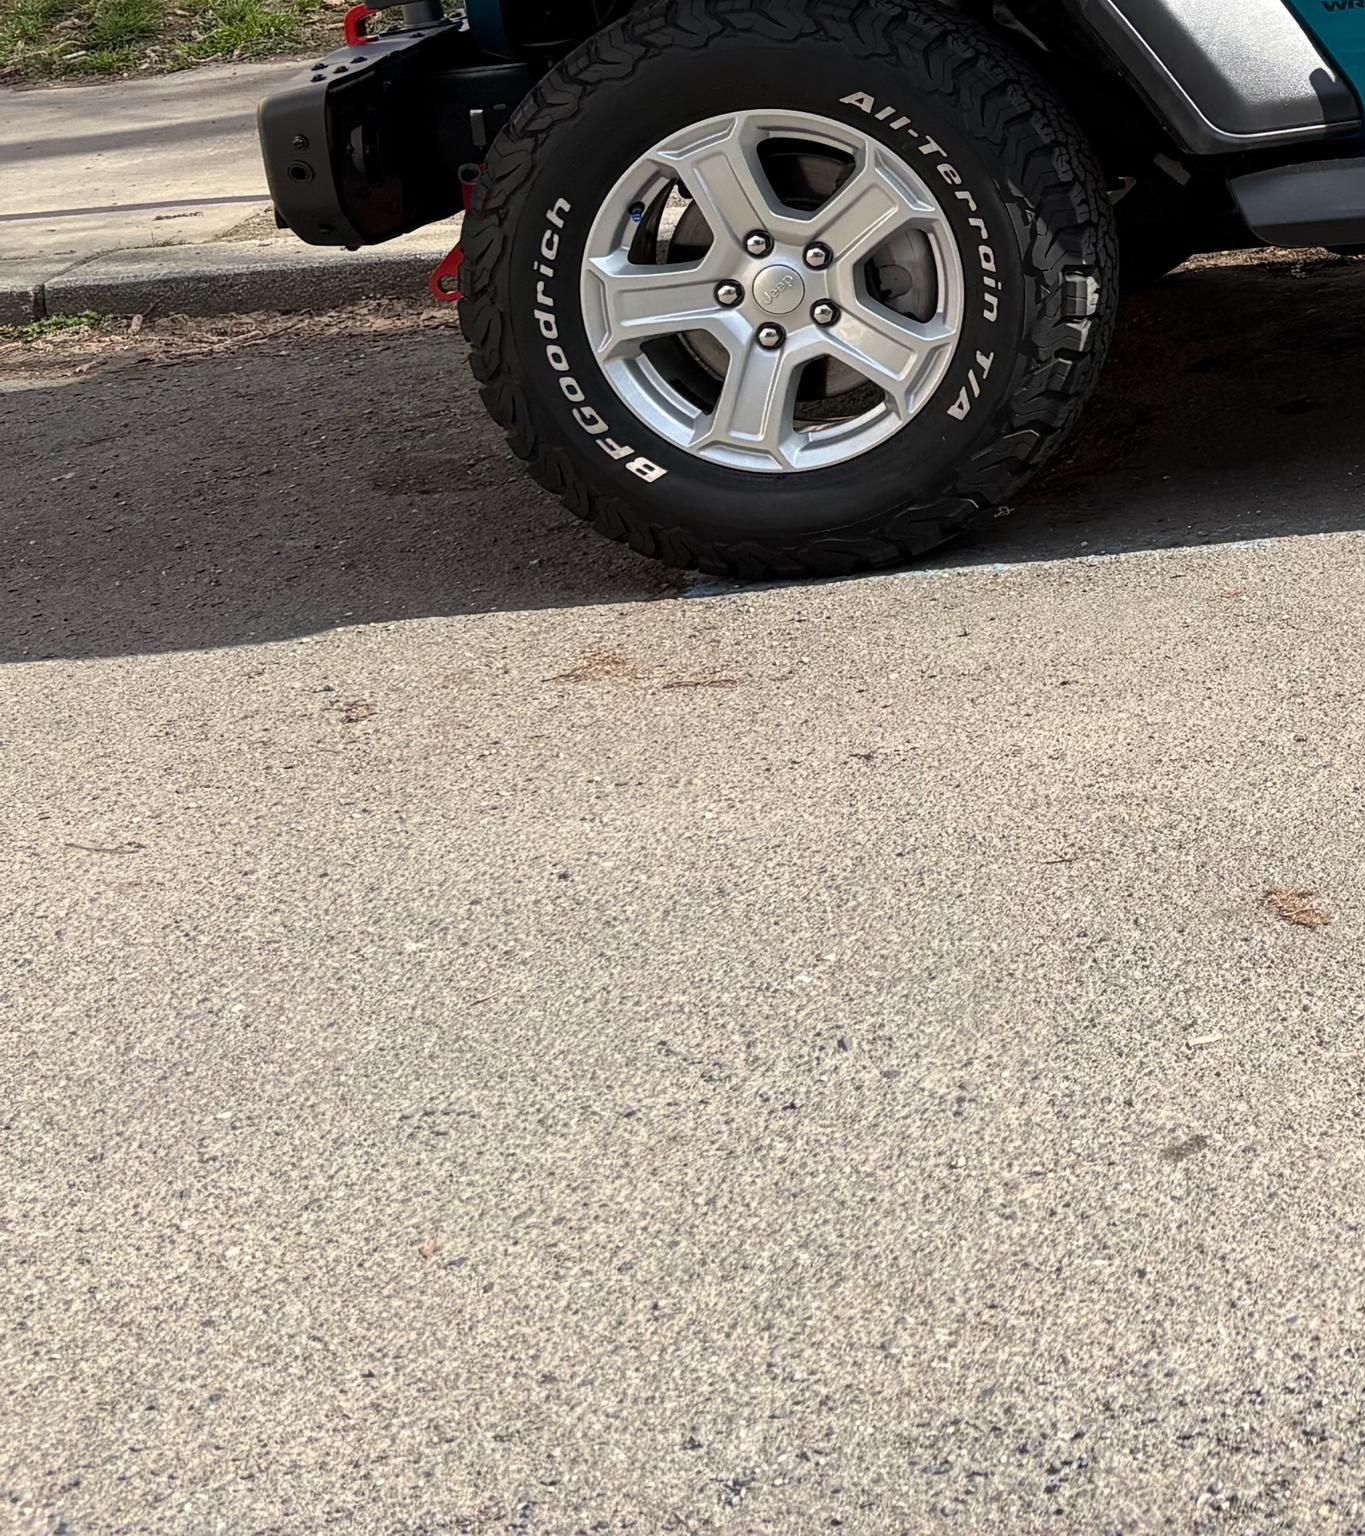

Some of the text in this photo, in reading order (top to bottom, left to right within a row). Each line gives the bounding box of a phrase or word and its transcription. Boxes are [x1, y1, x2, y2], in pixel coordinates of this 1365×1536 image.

[531, 197, 669, 484] BFGoodrich
[763, 275, 794, 305] Jeep
[839, 91, 1002, 421] All-Terrain T/A
